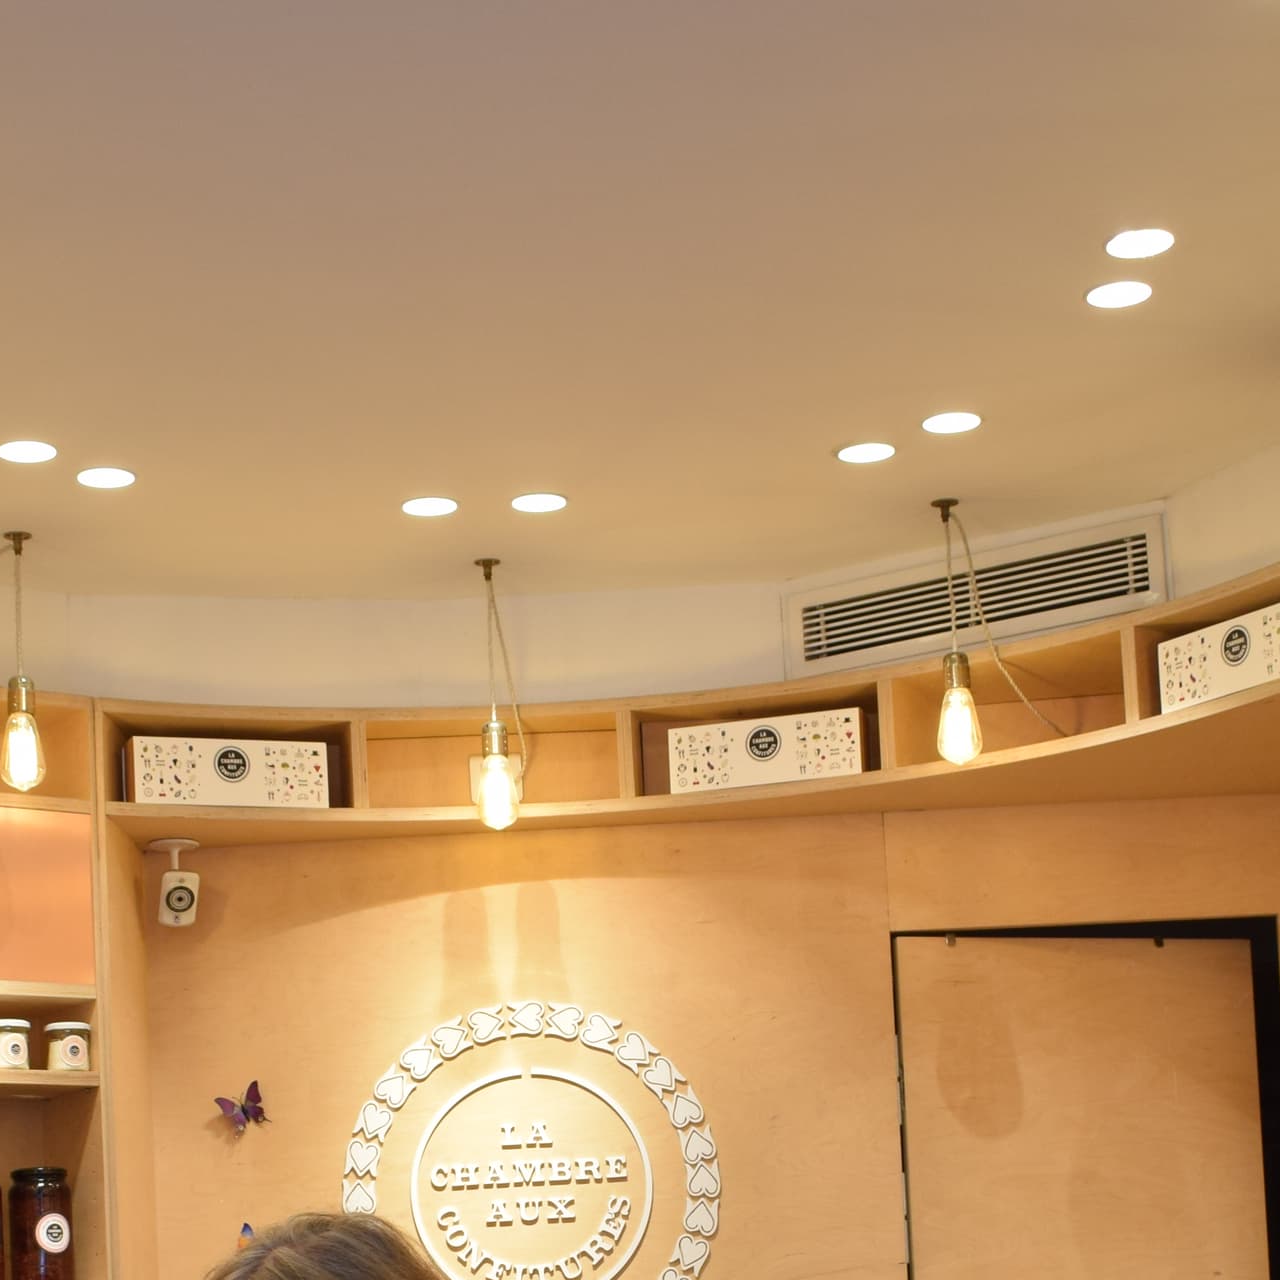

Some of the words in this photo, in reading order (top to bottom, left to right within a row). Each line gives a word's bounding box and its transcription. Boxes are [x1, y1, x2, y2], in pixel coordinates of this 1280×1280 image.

[500, 1122, 554, 1150] LA
[430, 1154, 628, 1191] CHAMBRE
[485, 1196, 577, 1228] AUX
